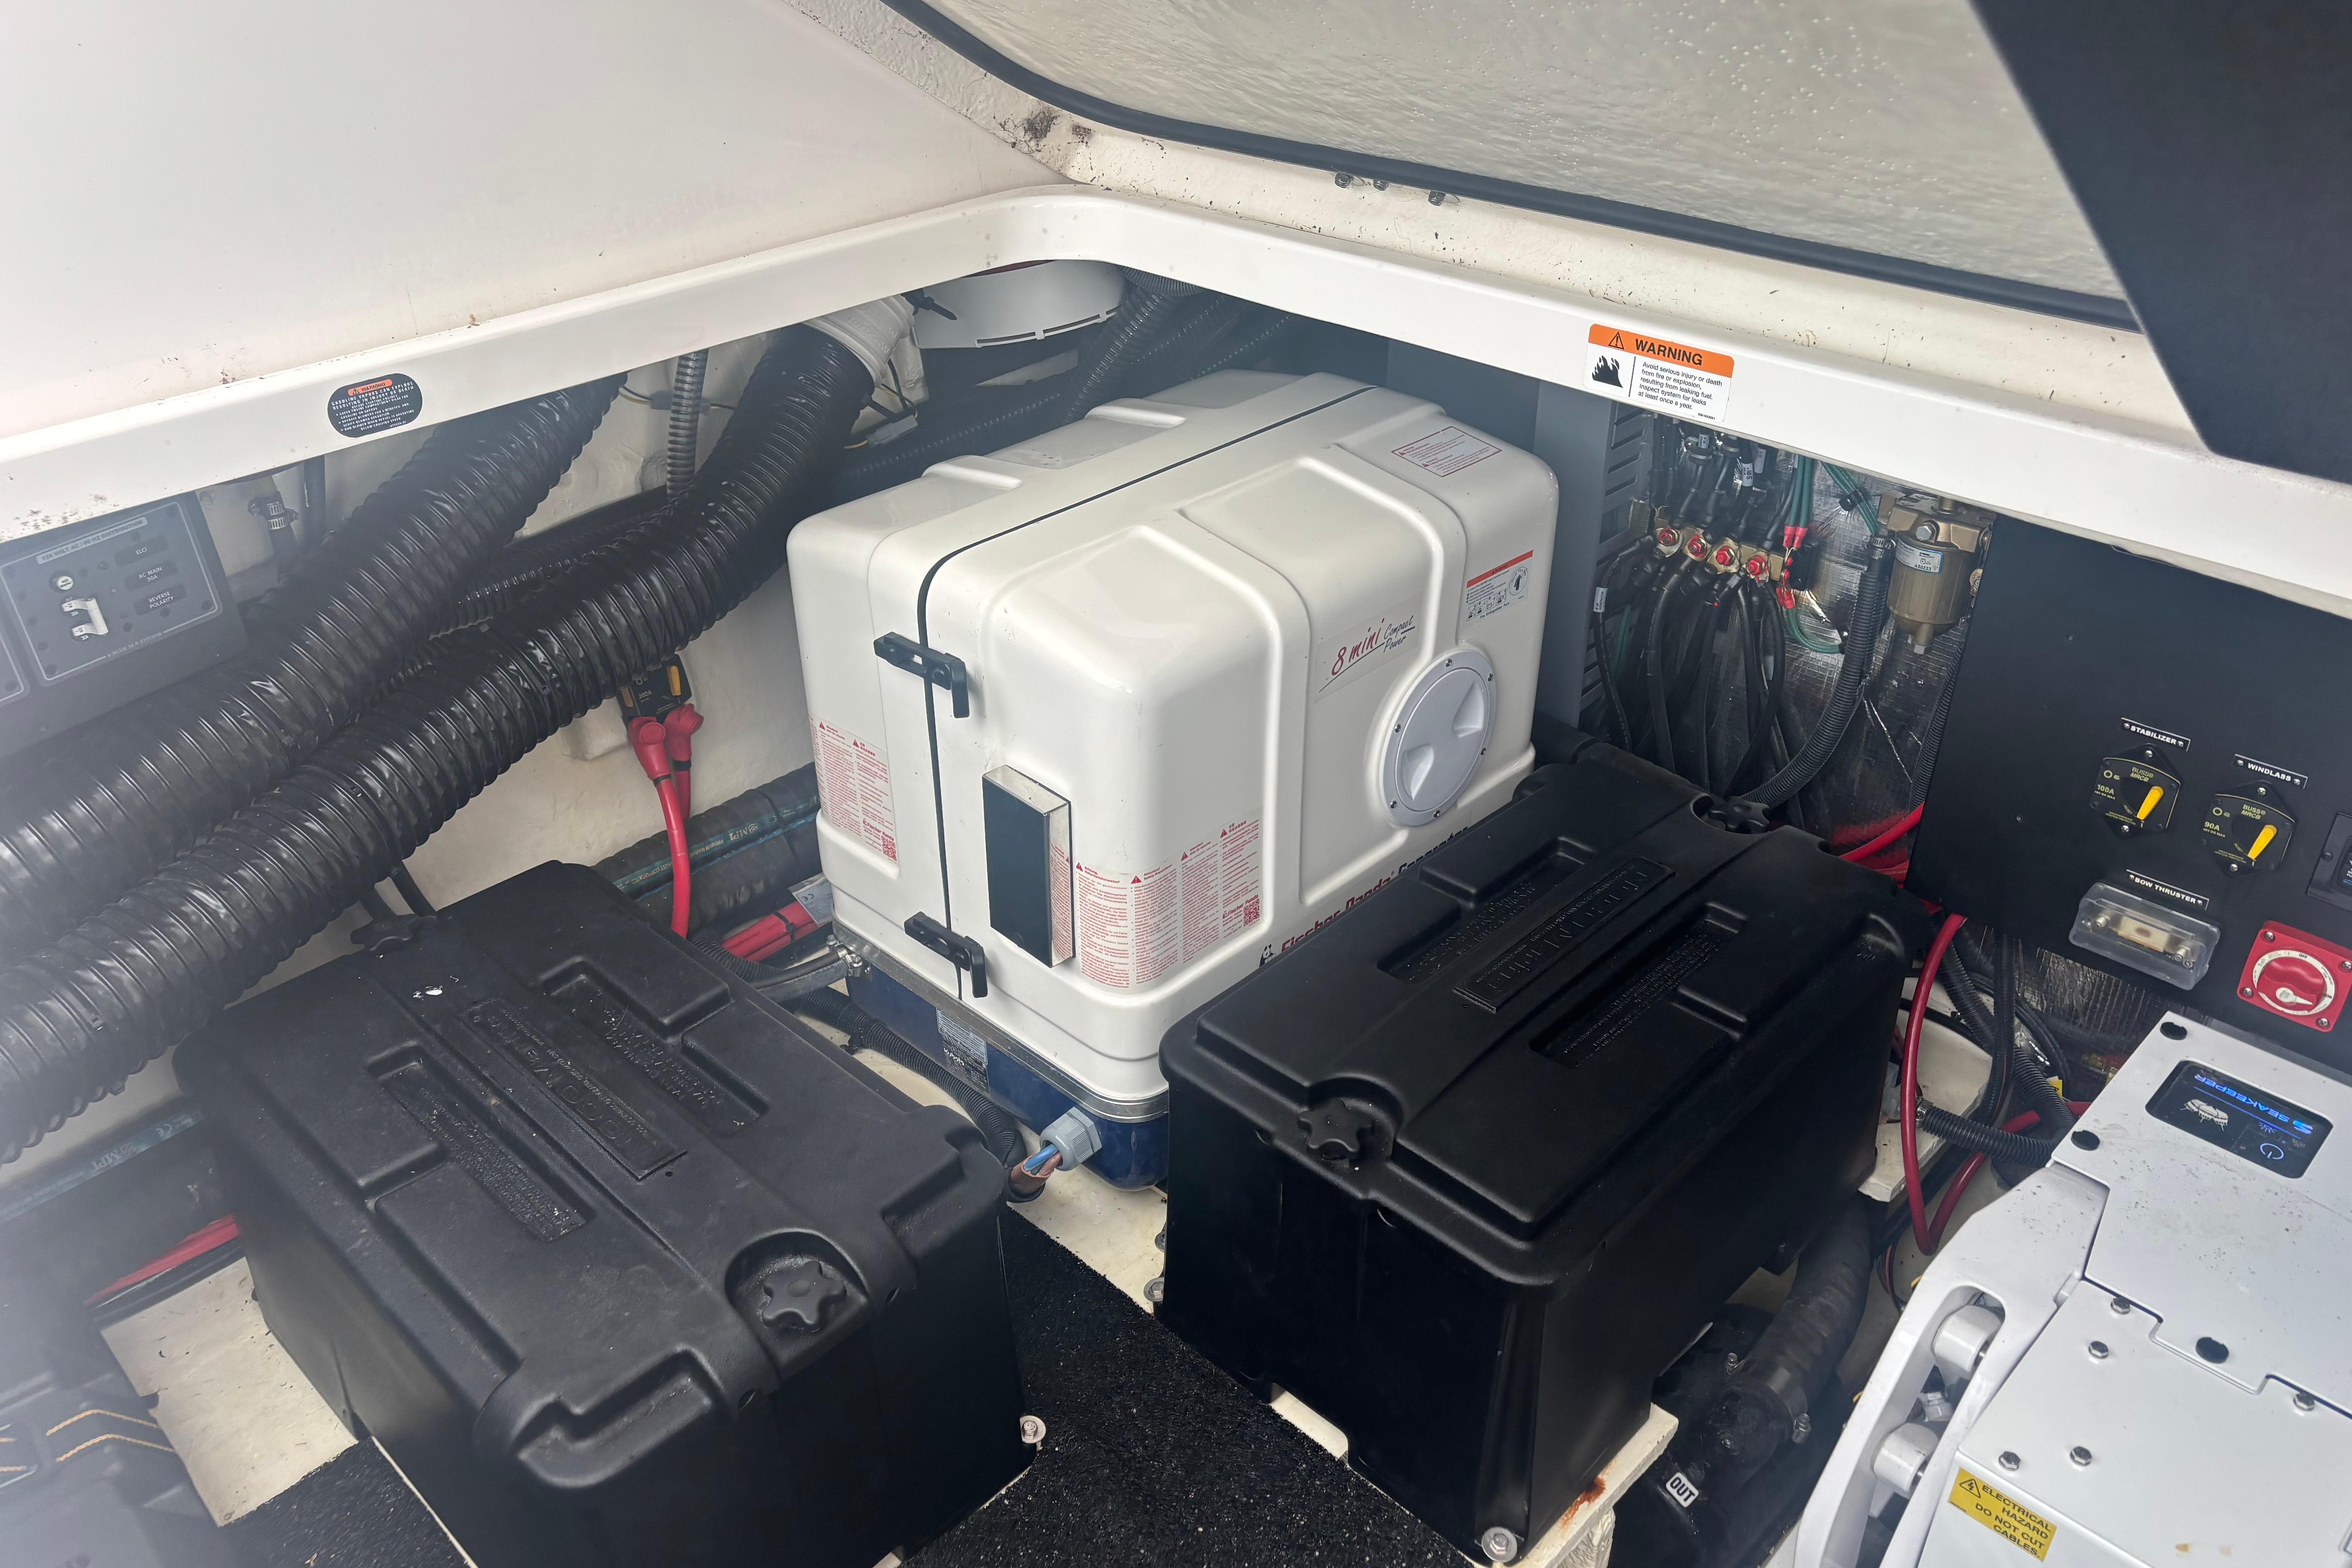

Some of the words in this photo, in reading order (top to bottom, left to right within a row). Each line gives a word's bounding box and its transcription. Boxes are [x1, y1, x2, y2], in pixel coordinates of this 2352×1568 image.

[1635, 338, 1703, 366] WARNING
[1643, 362, 1658, 371] Avoid
[1659, 367, 1680, 376] serious
[1681, 371, 1697, 381] injury
[1706, 378, 1722, 387] death
[1640, 377, 1664, 388] resulting
[1665, 382, 1678, 391] from
[1680, 386, 1699, 397] leaking
[1645, 392, 1658, 401] least
[1679, 401, 1692, 410] year.
[1661, 390, 1681, 399] system
[1692, 396, 1706, 406] leaks
[147, 566, 162, 576] MAIN
[149, 591, 170, 603] REVERSE
[149, 596, 173, 609] POLARITY
[1384, 614, 1414, 640] Compact
[1332, 646, 1347, 676] 8
[1349, 618, 1385, 663] mini
[1383, 635, 1407, 653] Power
[2130, 725, 2177, 746] STABILIZER
[2247, 762, 2292, 782] WINDLASS
[2097, 784, 2114, 795] 100A
[728, 827, 748, 841] MPI
[2204, 821, 2220, 831] 90A
[2134, 877, 2154, 889] BOW
[2154, 883, 2197, 905] THRUSTER
[2194, 1073, 2290, 1123] SEAKEEPER
[91, 1150, 122, 1171] MPI
[1670, 1476, 1696, 1503] OUT
[1981, 1484, 2051, 1532] ELECTRICAL
[1975, 1503, 1992, 1517] DO
[1994, 1514, 2019, 1534] NOT
[2022, 1532, 2046, 1549] CUT
[2002, 1507, 2049, 1540] HAZARD
[1993, 1525, 2040, 1558] CABLES.
